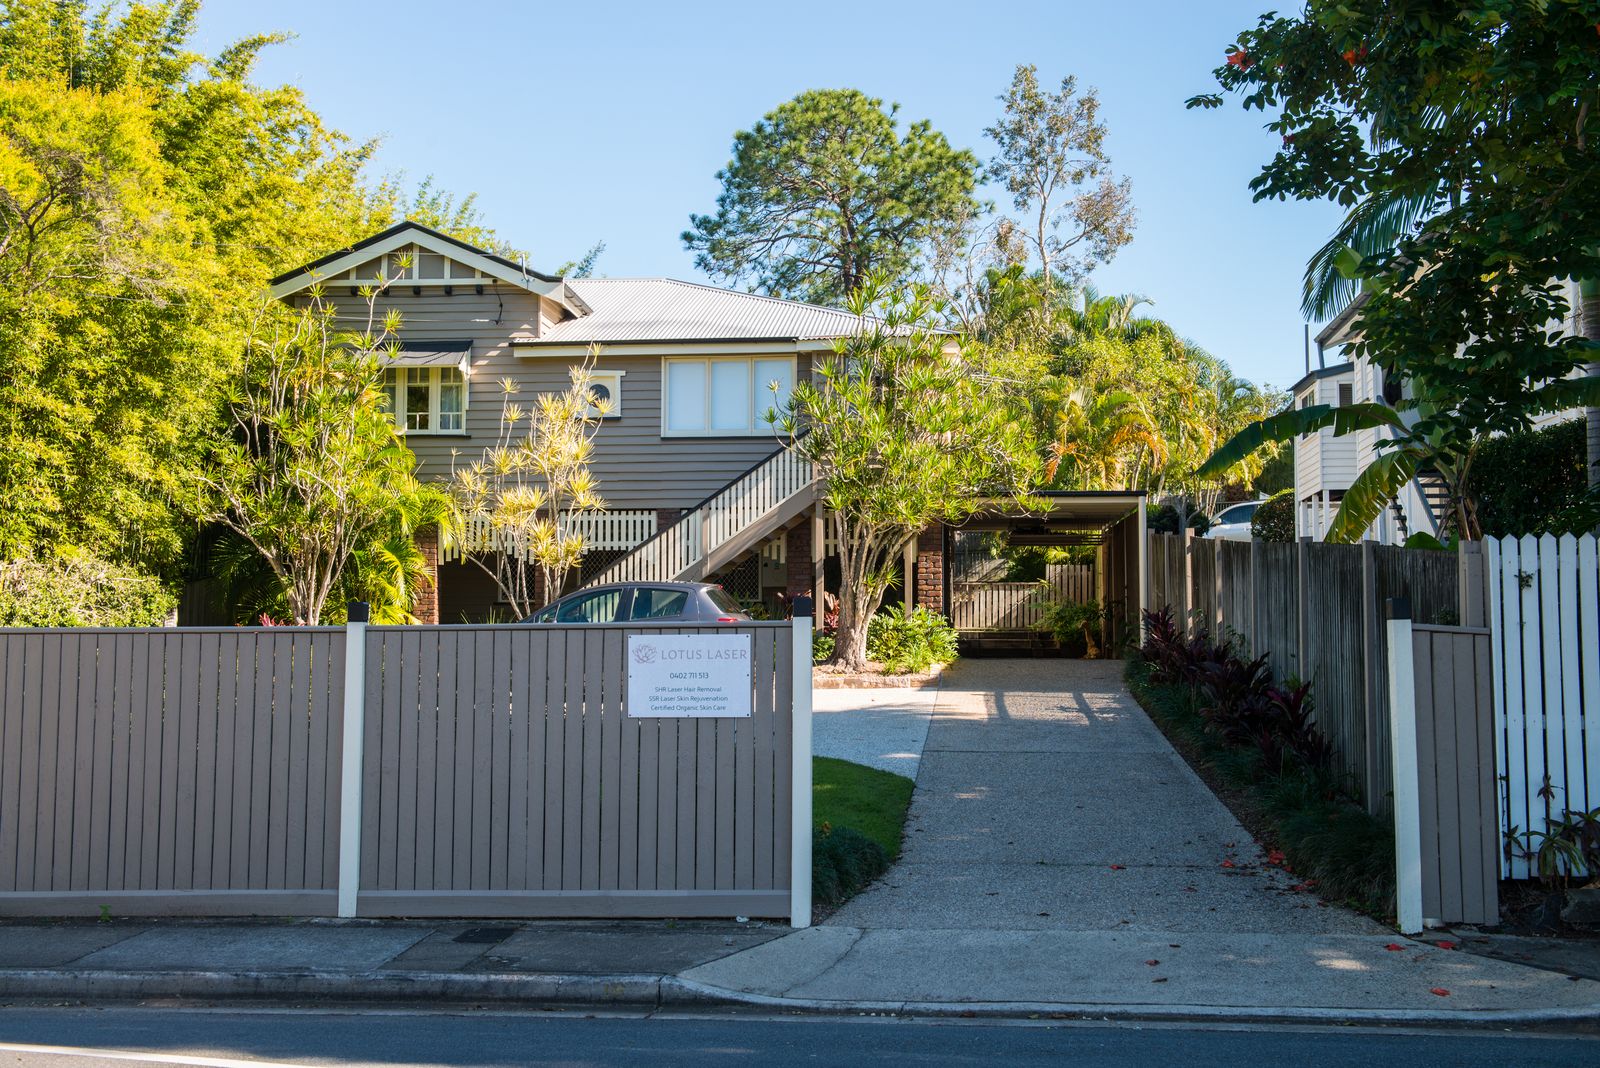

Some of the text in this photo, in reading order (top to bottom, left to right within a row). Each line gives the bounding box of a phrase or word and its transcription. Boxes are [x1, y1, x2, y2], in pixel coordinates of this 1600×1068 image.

[661, 649, 747, 660] LOTUS LASER
[676, 704, 698, 713] Organic
